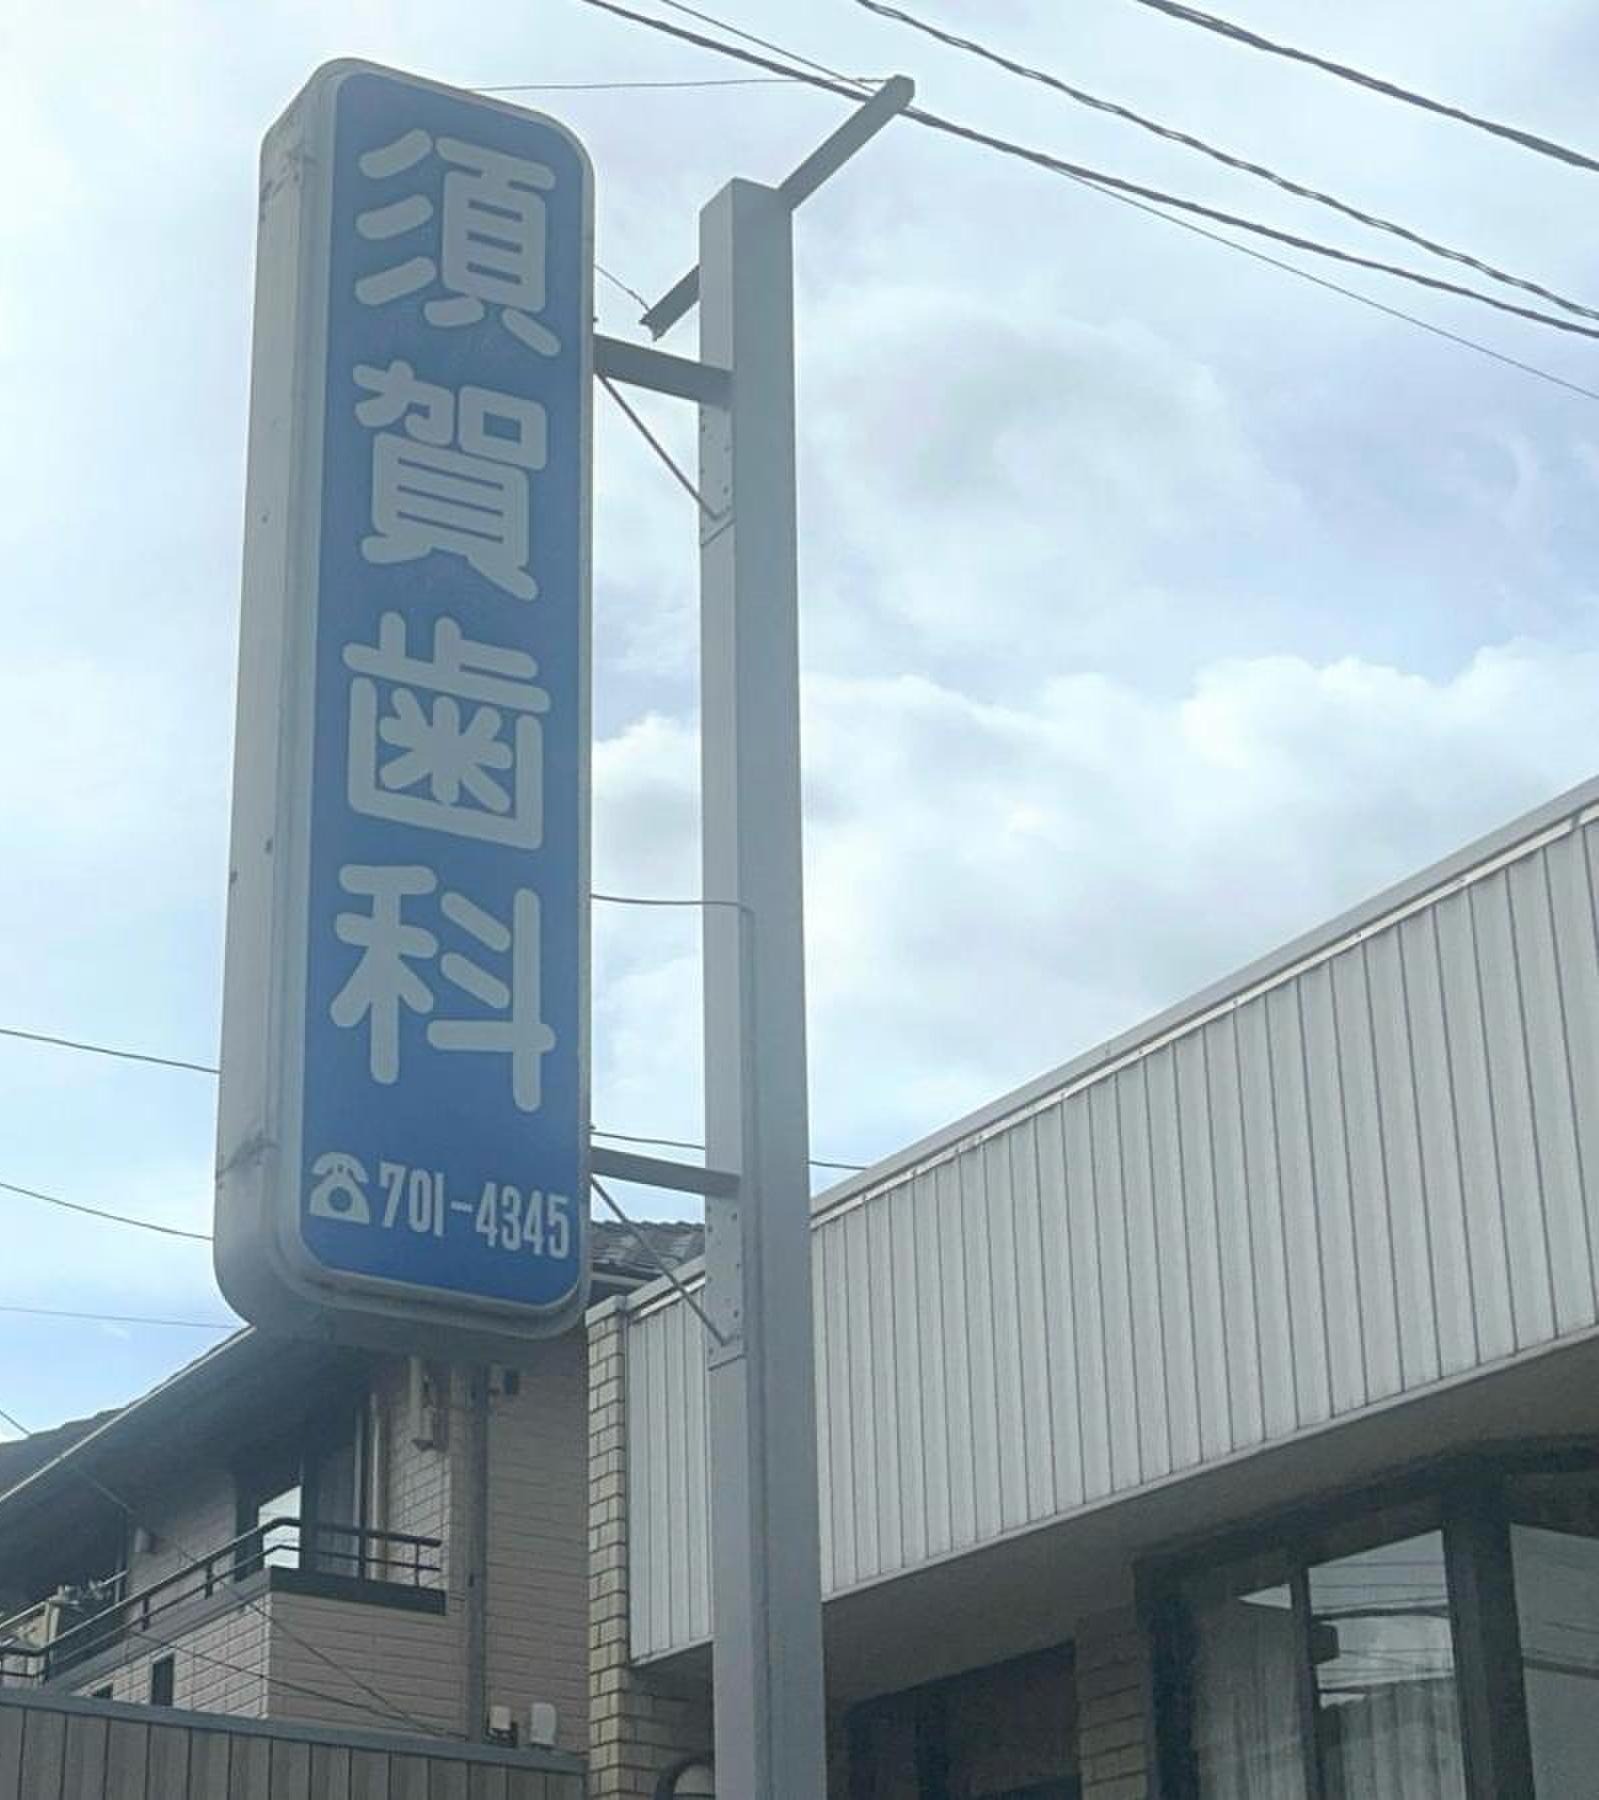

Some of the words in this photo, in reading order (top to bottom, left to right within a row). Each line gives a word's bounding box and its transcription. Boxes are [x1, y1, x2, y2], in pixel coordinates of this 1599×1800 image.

[329, 128, 562, 1113] 須賀歯科
[378, 1161, 571, 1259] 701-4345
